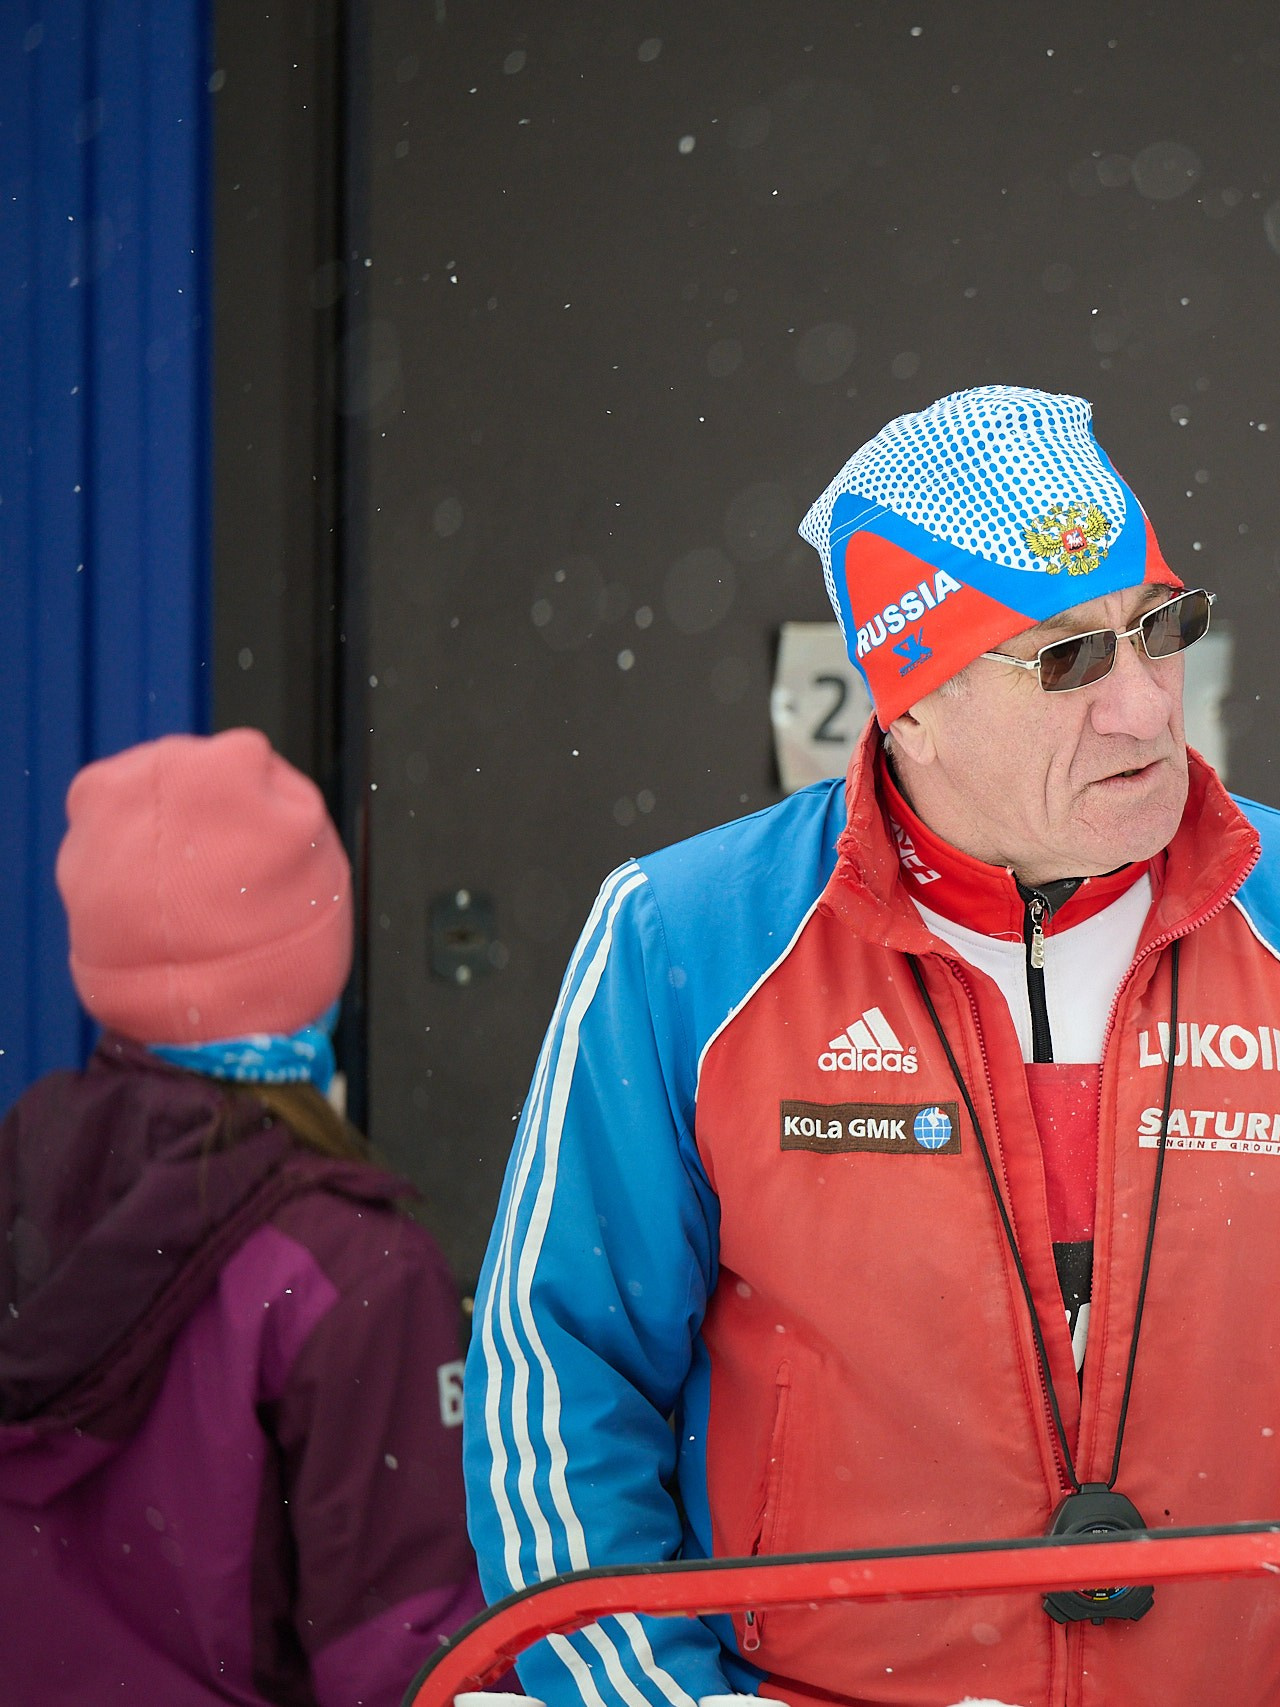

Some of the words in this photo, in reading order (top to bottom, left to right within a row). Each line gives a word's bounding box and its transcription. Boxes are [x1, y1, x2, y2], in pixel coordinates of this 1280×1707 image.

[855, 568, 964, 659] RUSSIA
[813, 674, 847, 743] 2
[817, 1046, 919, 1074] adidas
[848, 1118, 907, 1140] GMK
[1156, 1138, 1218, 1150] ENGINE
